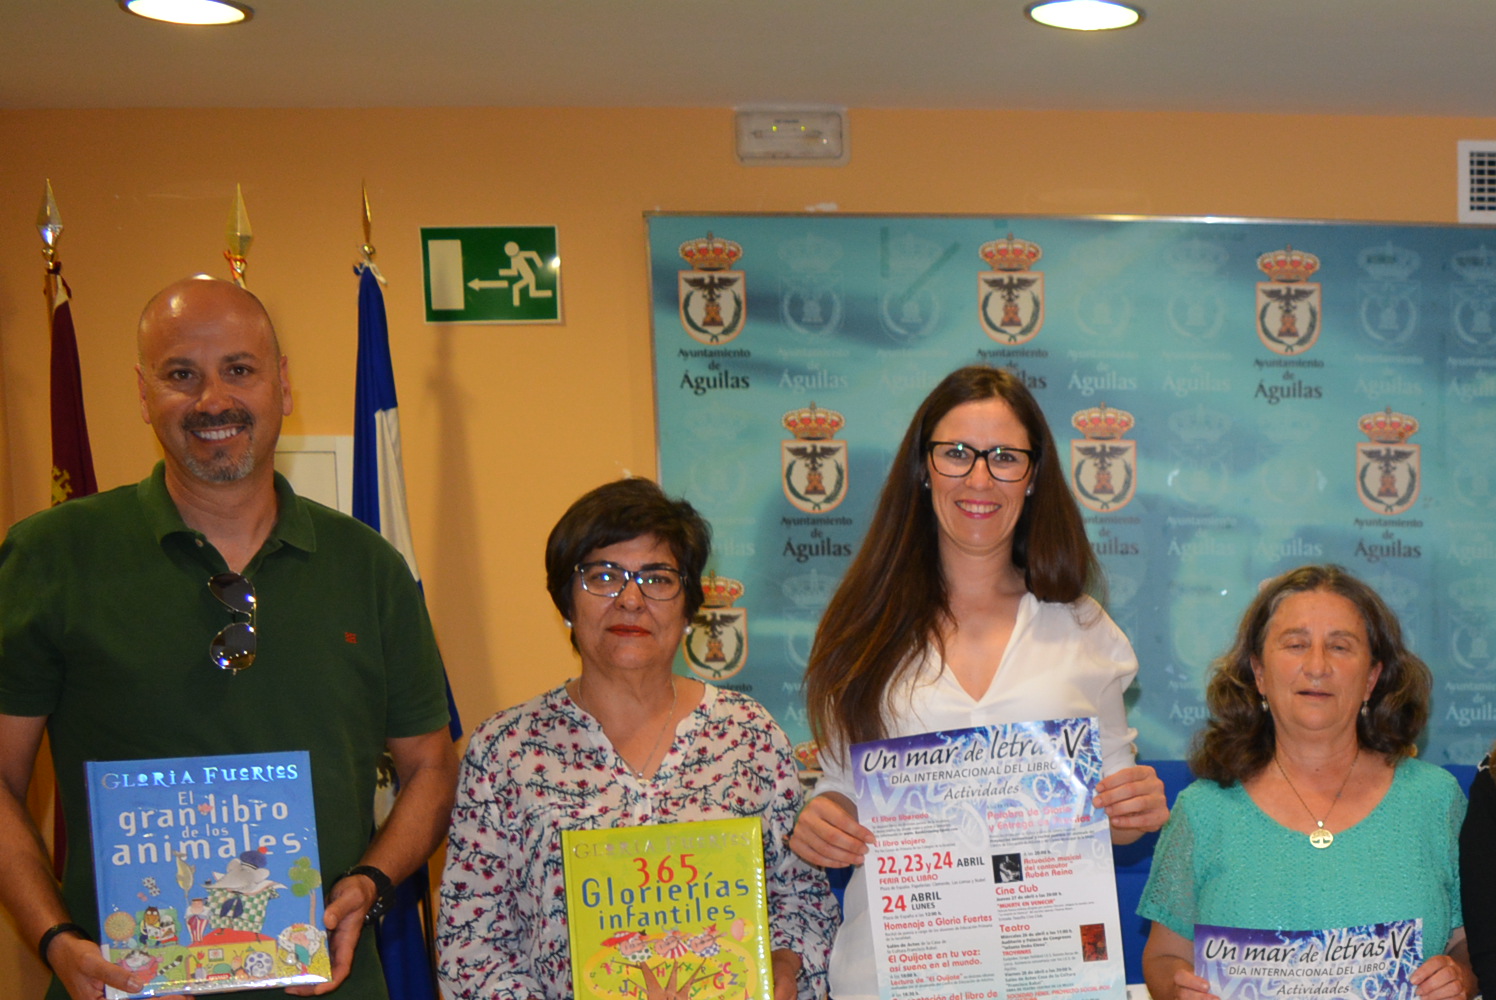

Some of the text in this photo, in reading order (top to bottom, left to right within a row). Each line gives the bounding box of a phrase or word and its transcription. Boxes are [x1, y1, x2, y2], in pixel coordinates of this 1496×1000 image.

[678, 348, 750, 360] Ayuntamiento
[977, 348, 1048, 360] Ayuntamiento
[708, 360, 720, 370] de
[1253, 358, 1324, 370] Ayuntamiento
[680, 371, 750, 396] Águilas
[1283, 371, 1294, 380] de
[1067, 372, 1137, 396] Águilas
[1254, 380, 1323, 405] Águilas
[781, 516, 852, 528] Ayuntamiento
[1080, 515, 1140, 525] untamiento
[1353, 518, 1424, 529] Ayuntamiento
[810, 528, 823, 538] de
[1099, 527, 1111, 537] de
[1382, 530, 1394, 539] de
[783, 538, 852, 563] Águilas
[1093, 538, 1139, 557] uilas
[1354, 540, 1422, 563] Águilas
[864, 750, 897, 773] Un
[906, 745, 957, 766] mar
[963, 741, 984, 762] de
[1064, 725, 1087, 759] V
[891, 772, 911, 785] DÍA
[914, 766, 1002, 784] INTERNACIONAL
[1004, 765, 1024, 776] DEL
[178, 790, 194, 805] El
[943, 781, 1020, 800] Actividades
[119, 793, 289, 837] gran libro
[181, 823, 229, 839] de los
[112, 823, 302, 866] animales
[883, 839, 899, 847] libro
[901, 838, 926, 846] viajero
[904, 854, 924, 872] 23
[926, 862, 932, 873] y
[932, 851, 953, 870] 24
[957, 856, 985, 867] ABRIL
[633, 853, 698, 889] 365
[901, 875, 915, 883] DEL
[917, 874, 938, 882] LIBRO
[581, 871, 750, 908] Glorierías
[995, 885, 1039, 895] Cine Club
[882, 891, 942, 913] 24 ABRIL
[911, 902, 936, 911] LUNES
[599, 896, 736, 931] infantiles
[884, 921, 925, 931] Homenaje
[935, 916, 961, 926] Gloria
[963, 914, 993, 924] Fuertes
[1000, 923, 1030, 933] Teatro
[1205, 926, 1412, 963] Un mar de letras V
[888, 948, 981, 964] El Quijote en tu voz:
[942, 959, 950, 968] el
[952, 958, 982, 967] mundo.
[1228, 961, 1386, 977] DÍA INTERNACIONAL DEL LIBRO
[965, 991, 985, 999] libro
[987, 990, 998, 998] de
[1276, 981, 1350, 996] Actividades
